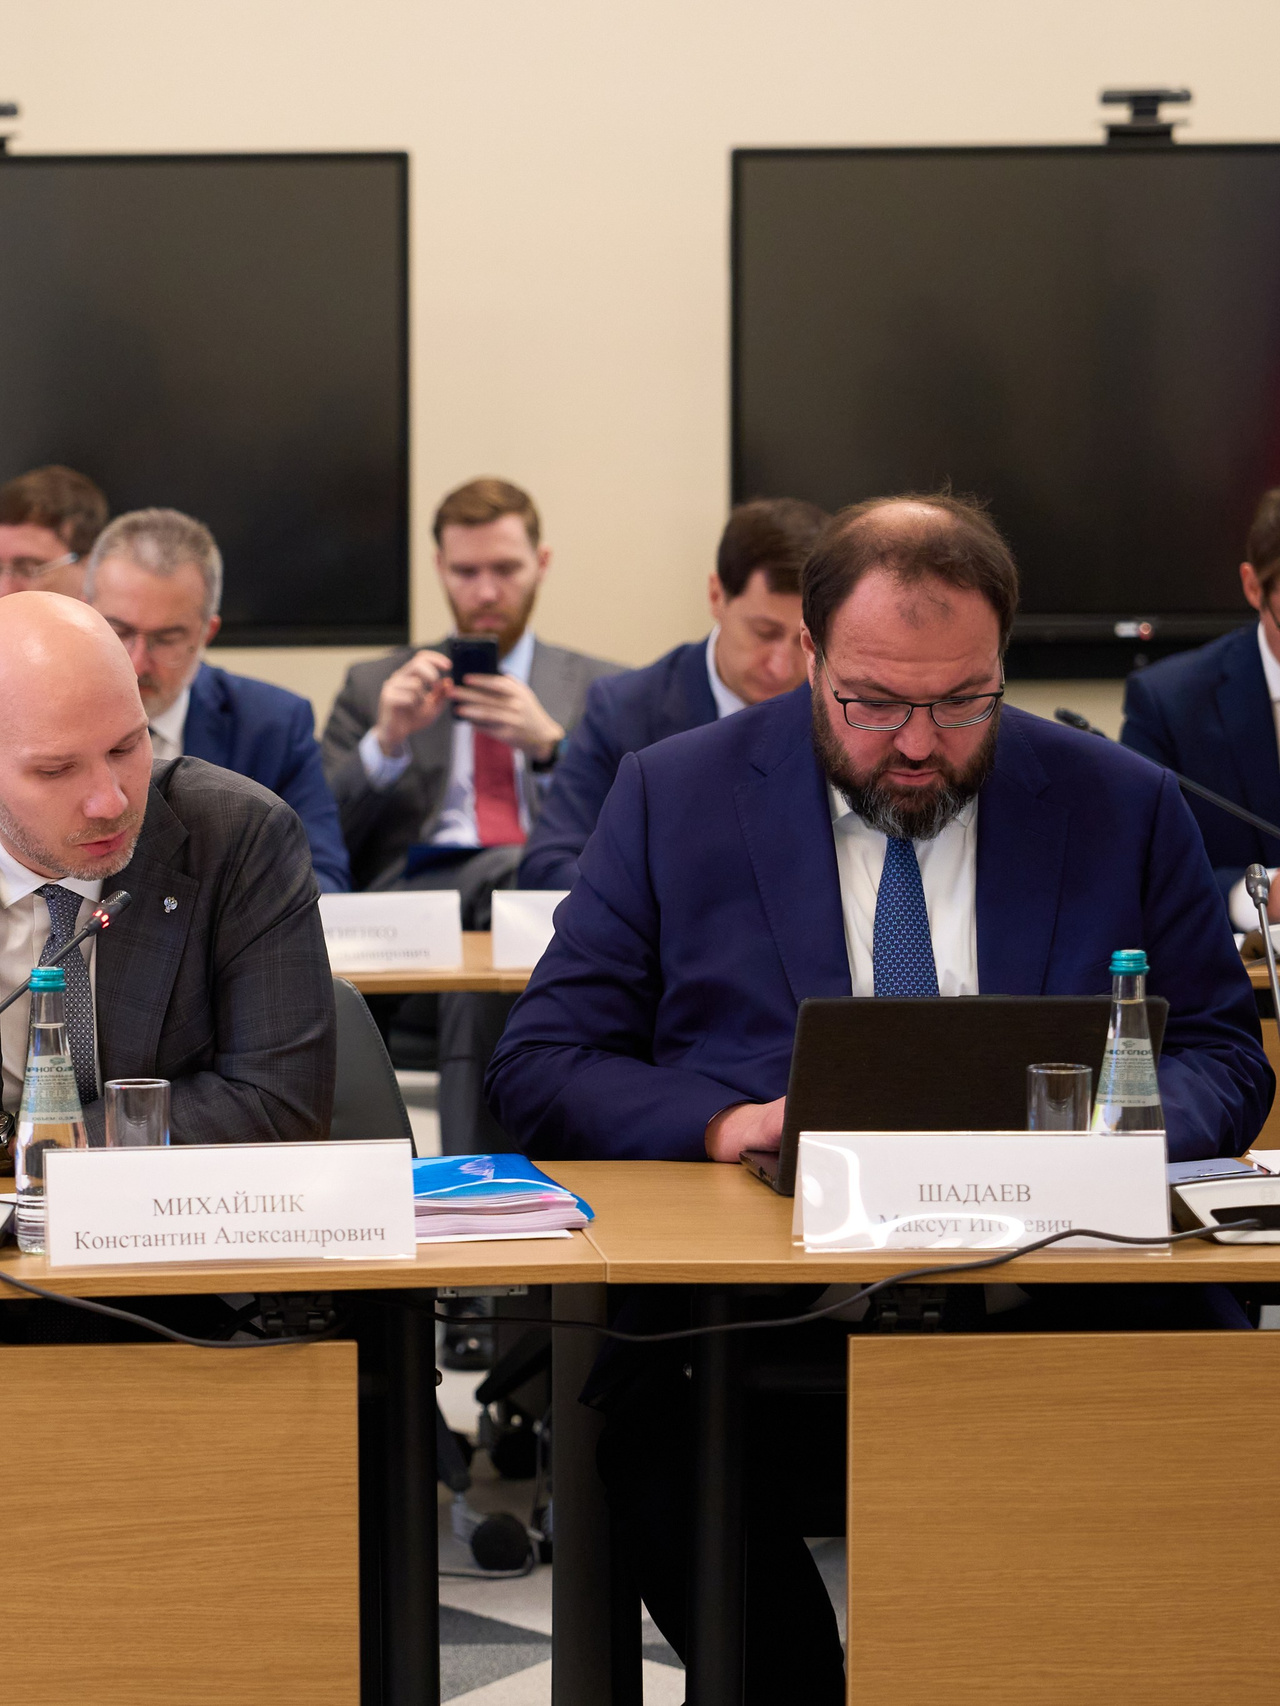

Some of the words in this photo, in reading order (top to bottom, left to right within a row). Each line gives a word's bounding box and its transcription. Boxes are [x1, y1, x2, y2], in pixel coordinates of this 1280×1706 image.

[152, 1190, 306, 1217] МИХАЙЛИК
[918, 1183, 1032, 1206] ШАДАЕВ
[969, 1215, 1073, 1233] Игоевич
[74, 1229, 207, 1250] Константин
[213, 1226, 386, 1248] Александрович
